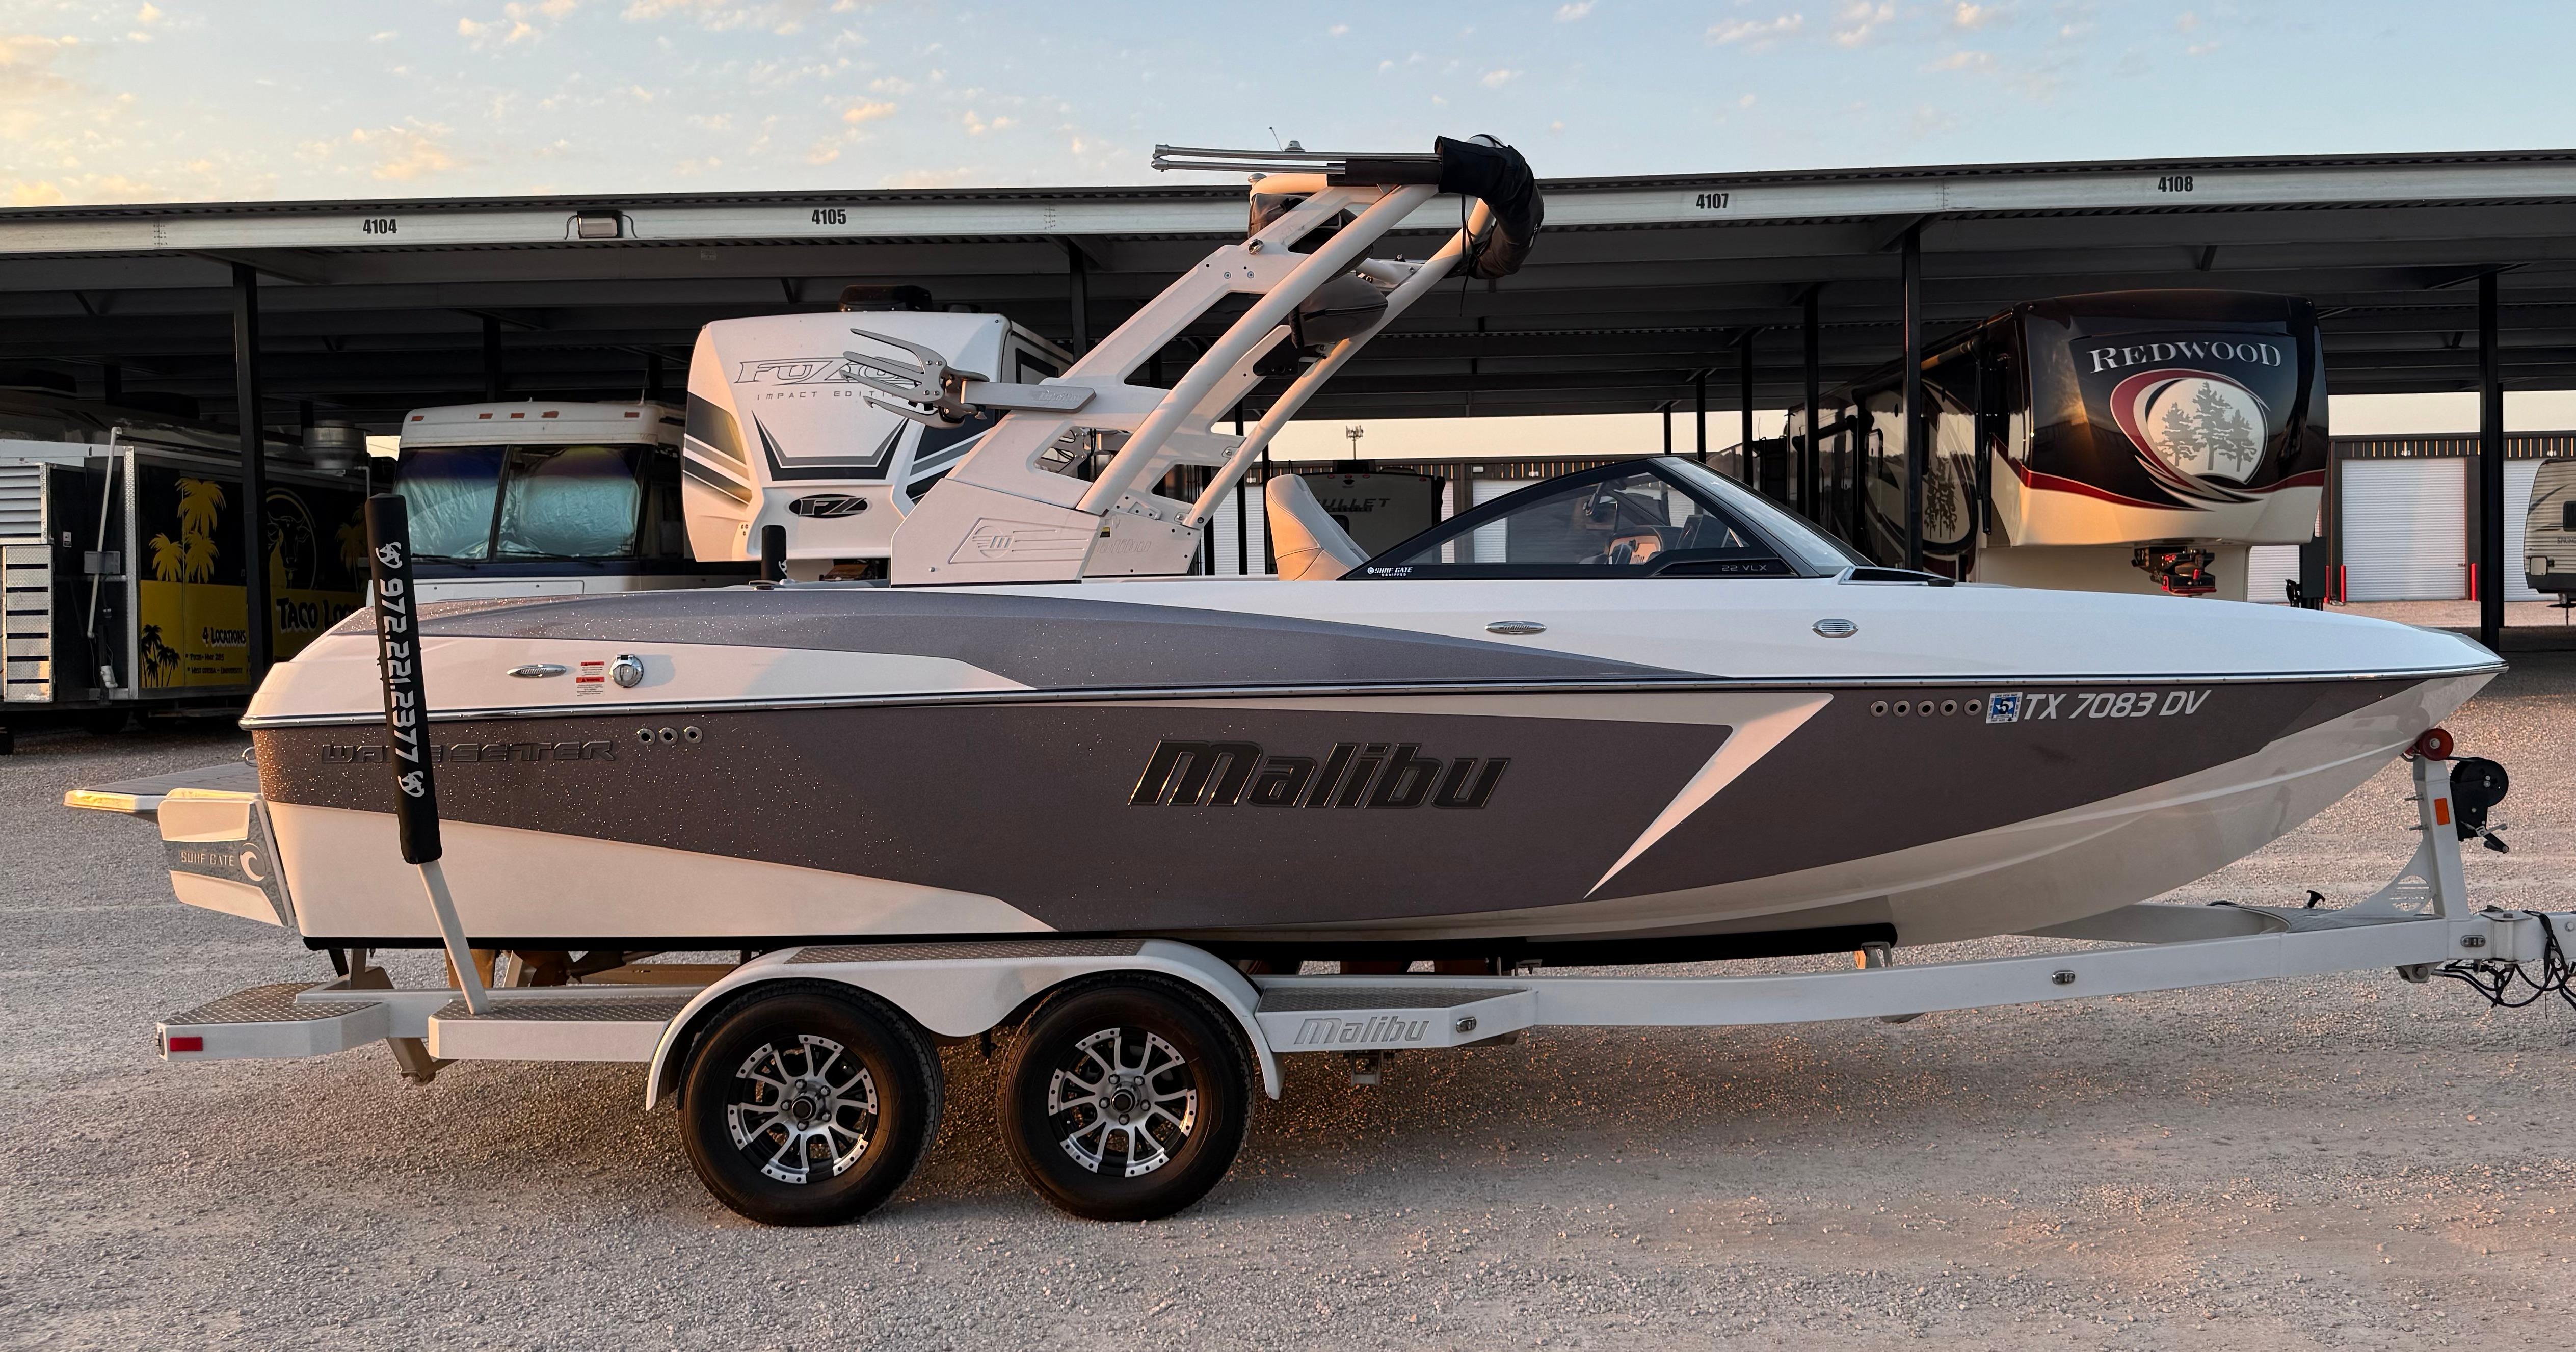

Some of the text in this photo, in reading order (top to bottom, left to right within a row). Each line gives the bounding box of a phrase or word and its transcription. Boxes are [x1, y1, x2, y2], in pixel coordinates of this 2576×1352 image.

[2158, 176, 2193, 192] 4108
[1696, 193, 1729, 209] 4107
[812, 209, 846, 224] 4105
[363, 219, 397, 234] 4104
[2087, 342, 2281, 373] REDWOOD
[757, 391, 817, 400] IMPACT
[798, 497, 866, 516] FZ
[1317, 498, 1391, 508] ULLET
[1097, 539, 1152, 554] alibu
[276, 597, 359, 631] TACO LO
[202, 626, 246, 645] 4 LOCATIONS
[380, 578, 419, 763] 972.221.2377
[1998, 699, 2010, 714] 5
[2024, 694, 2067, 720] TX
[2068, 692, 2157, 719] 7083
[2159, 690, 2212, 716] DV
[321, 740, 615, 763] WASETTER
[1127, 740, 1511, 809] Malibu
[181, 852, 235, 867] SURF GATE
[1293, 1016, 1430, 1045] Malibu
